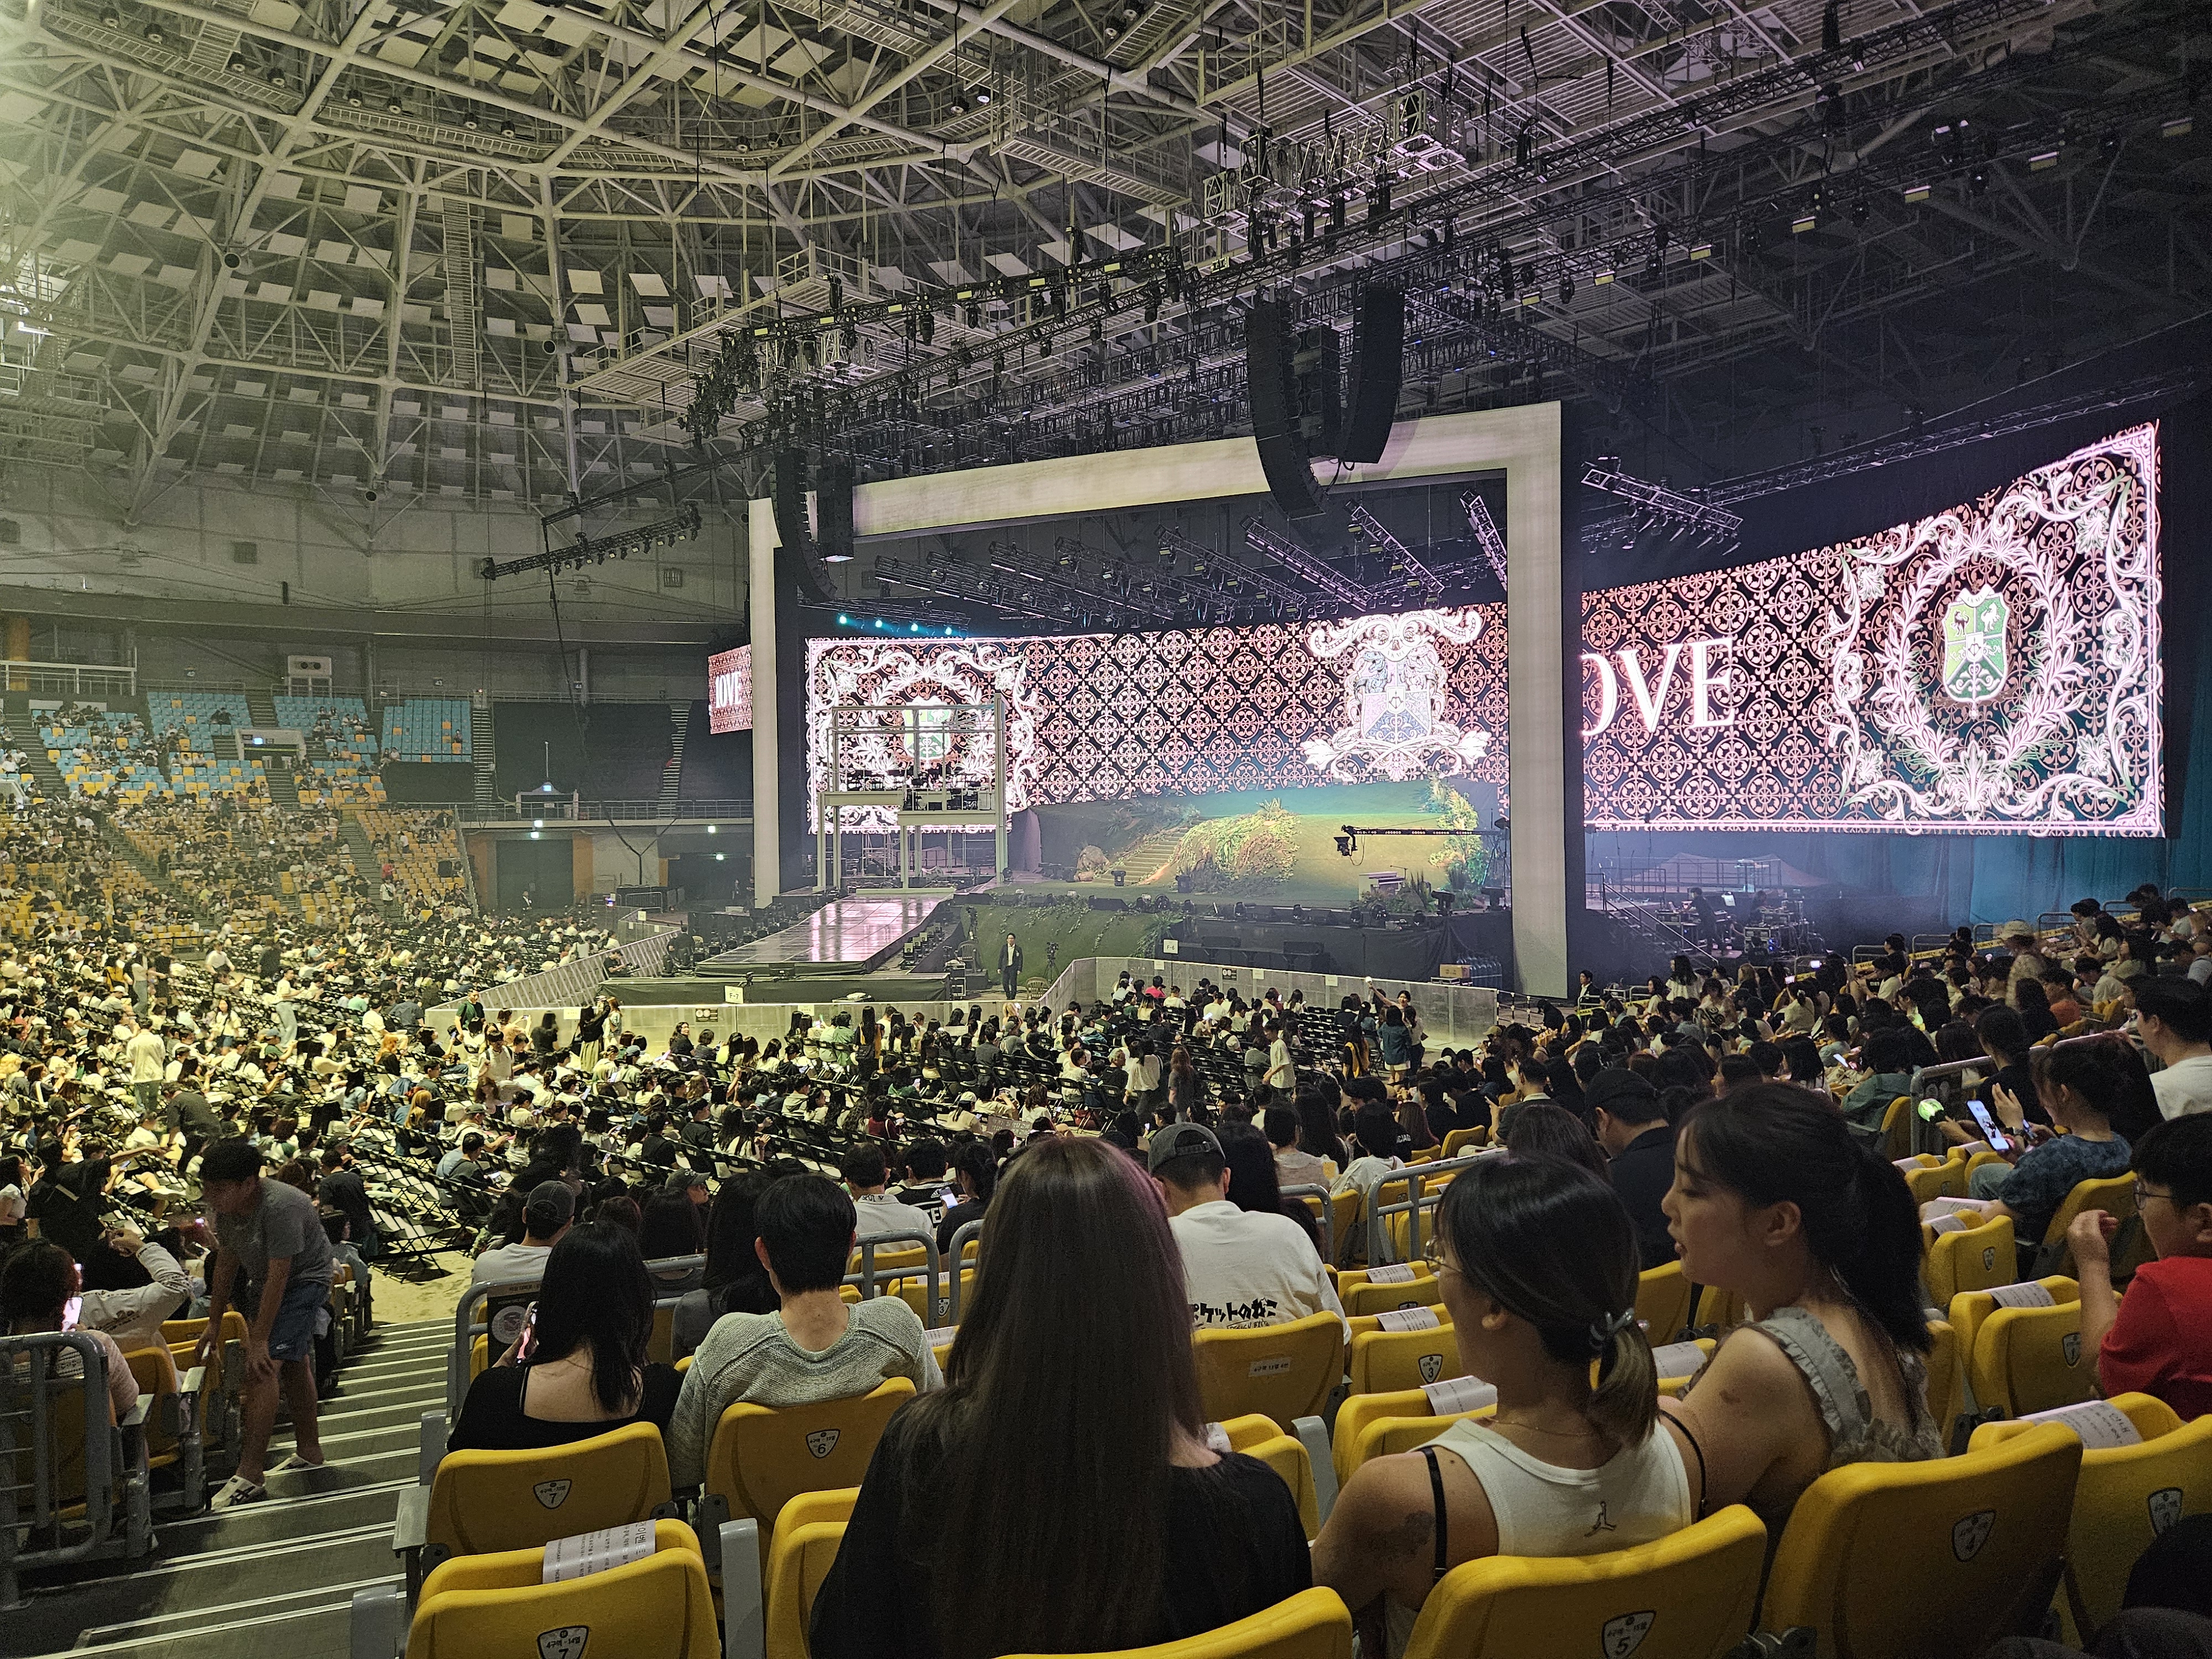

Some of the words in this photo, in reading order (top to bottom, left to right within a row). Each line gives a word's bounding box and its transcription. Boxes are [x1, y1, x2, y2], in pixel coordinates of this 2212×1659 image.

[1428, 1368, 1434, 1378] 3
[818, 1443, 826, 1454] 6
[549, 1493, 557, 1504] 7
[546, 1640, 562, 1649] 4구역
[1615, 1636, 1631, 1656] 5
[559, 1648, 569, 1659] 7
